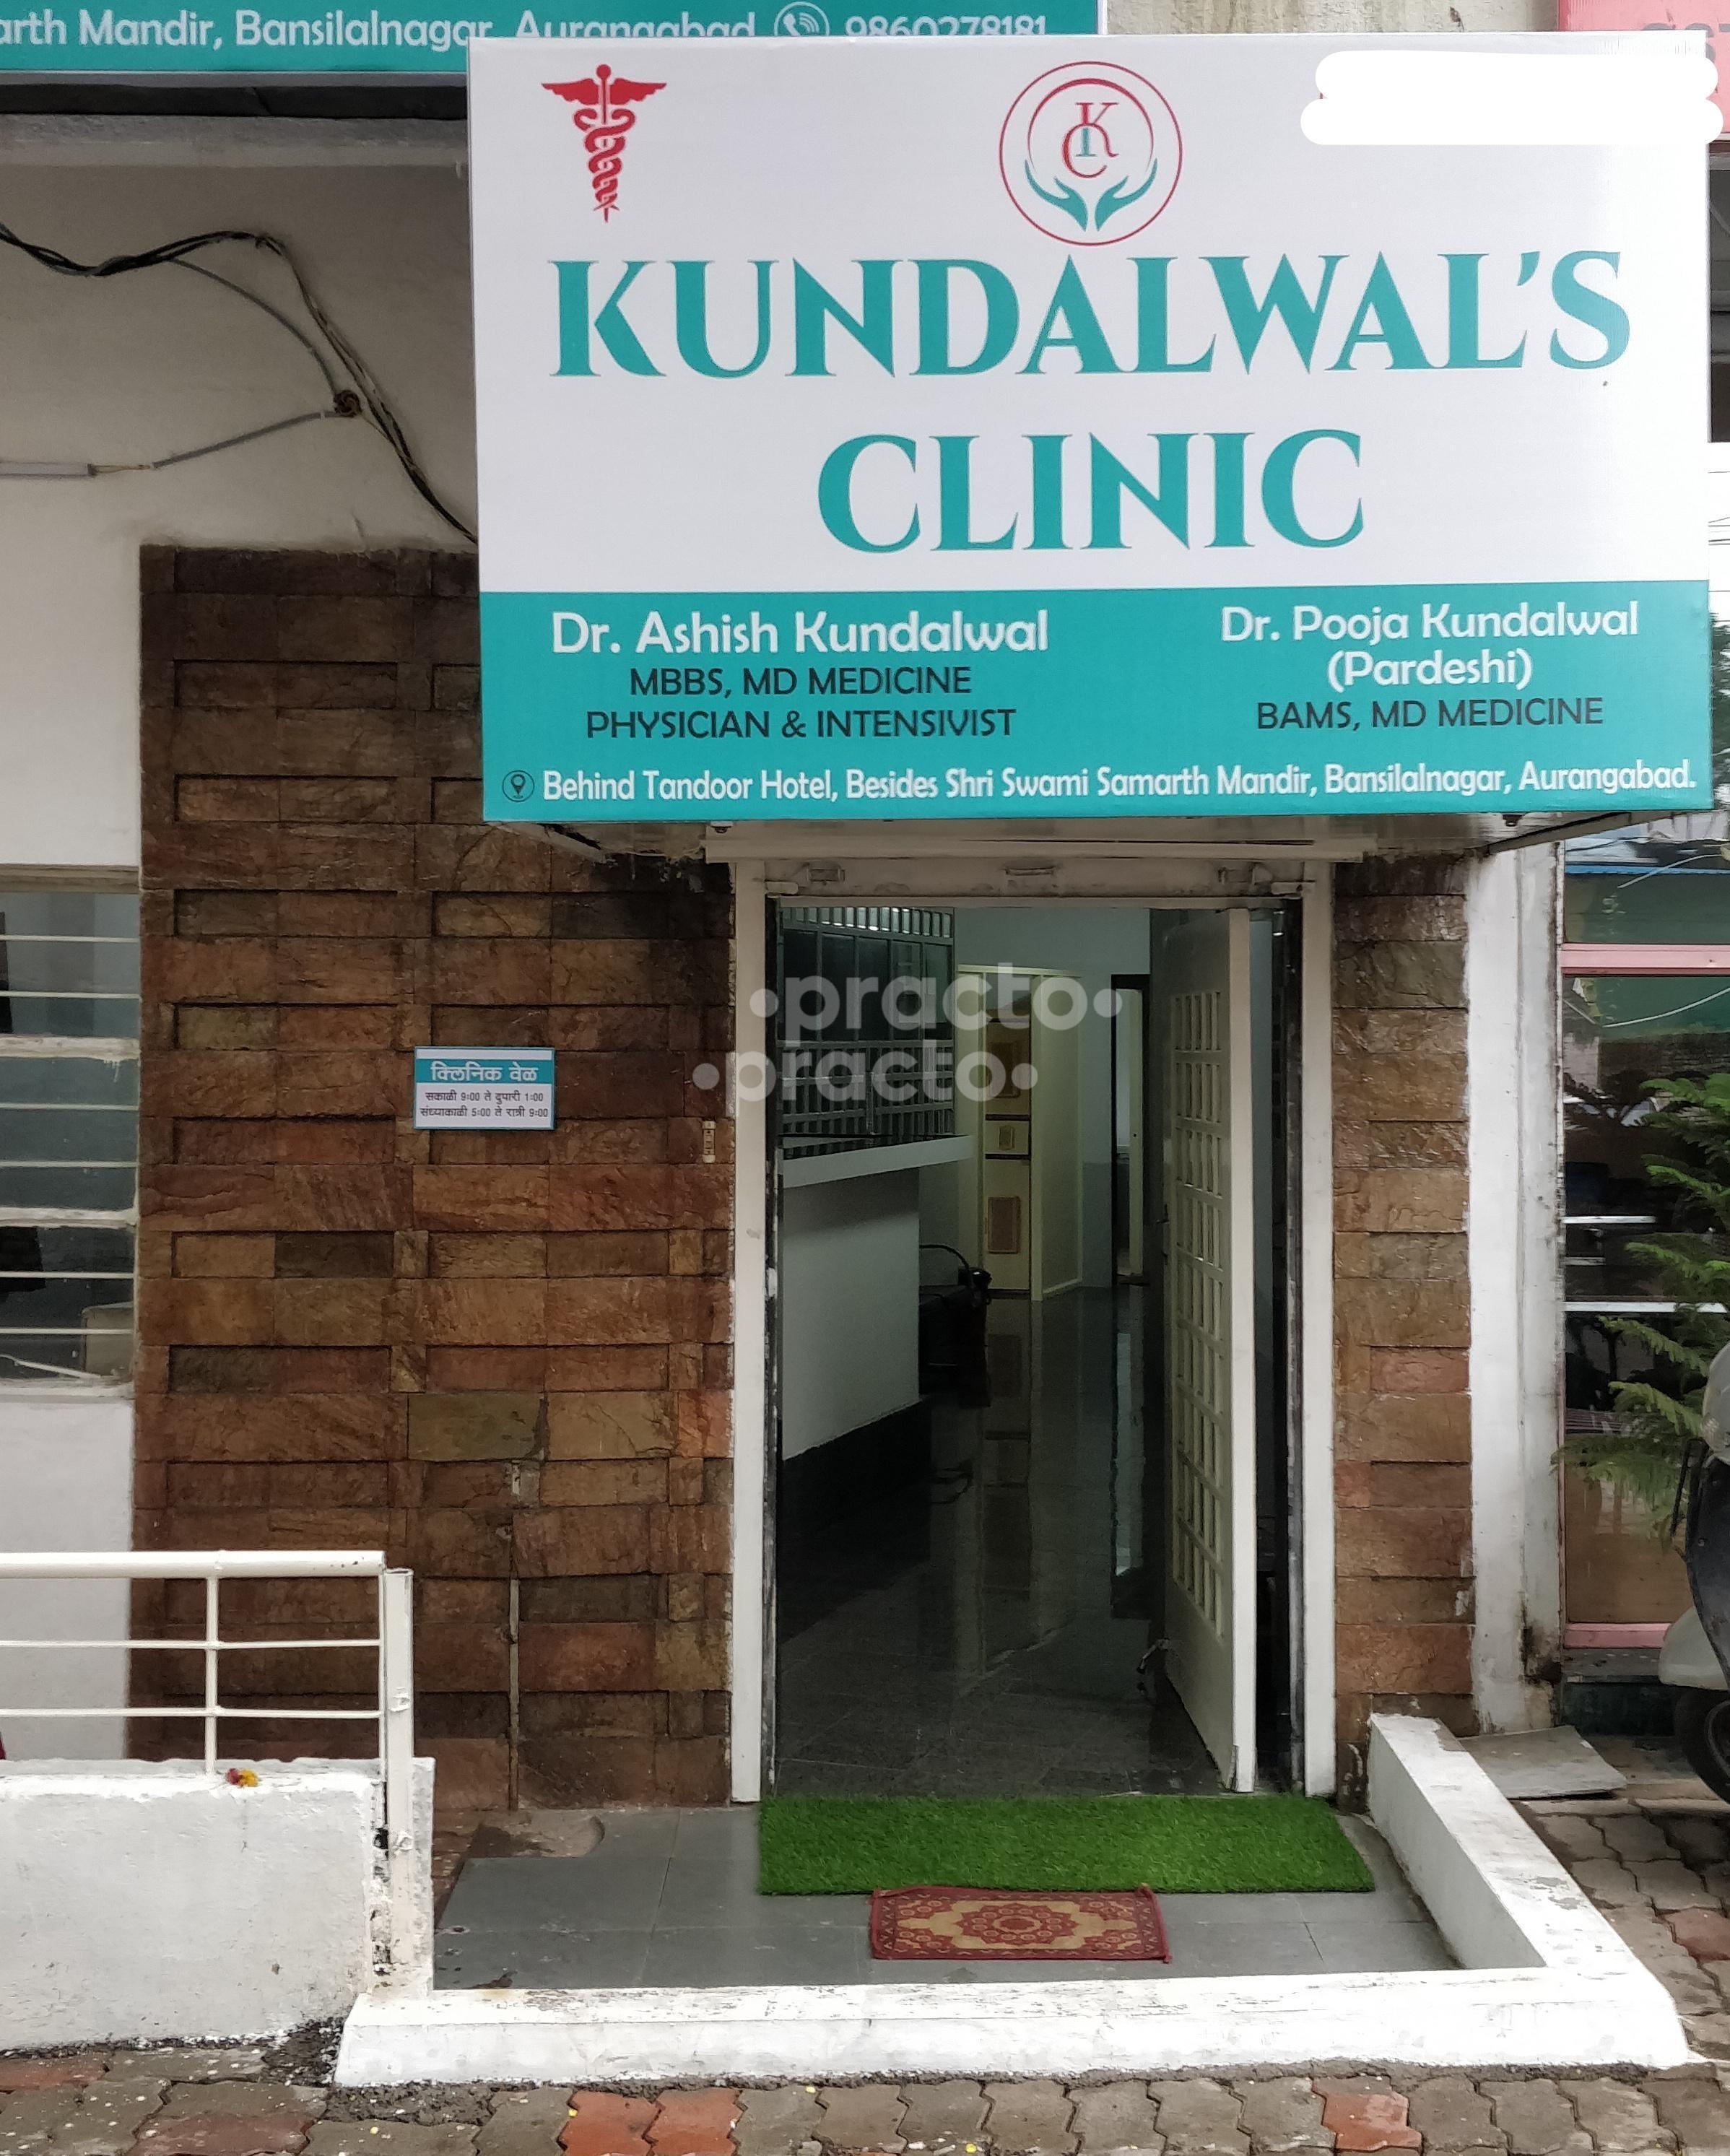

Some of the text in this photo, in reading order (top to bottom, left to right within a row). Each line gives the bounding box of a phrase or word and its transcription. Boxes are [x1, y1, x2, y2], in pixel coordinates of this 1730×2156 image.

[79, 9, 222, 51] Mandir,
[547, 250, 1630, 378] KUNDALWAL'S
[818, 429, 1364, 554] CLINIC
[552, 609, 1048, 653] Dr. Ashish Kundalwal
[1221, 600, 1639, 646] Dr. Pooja Kundalwal
[630, 666, 972, 699] MBBS, MD MEDICINE
[1328, 648, 1533, 692] (Pardeshi)
[586, 708, 1017, 739] PHYSICIAN & INTENSIVIST
[1256, 697, 1603, 731] BAMS, MD MEDICINE
[544, 758, 1697, 801] Behind Tandoor Hotel, Besides Shri Swami Samarth Mandir, Bansilalnagar, Aurangabad.
[430, 1061, 539, 1082] क्लिनिक वेळ
[425, 1089, 544, 1105] सकाळी 9:00 ते दुपारी 1:00
[471, 1108, 491, 1117] 5:00
[495, 1105, 503, 1117] ते
[529, 1108, 549, 1117] 9:00
